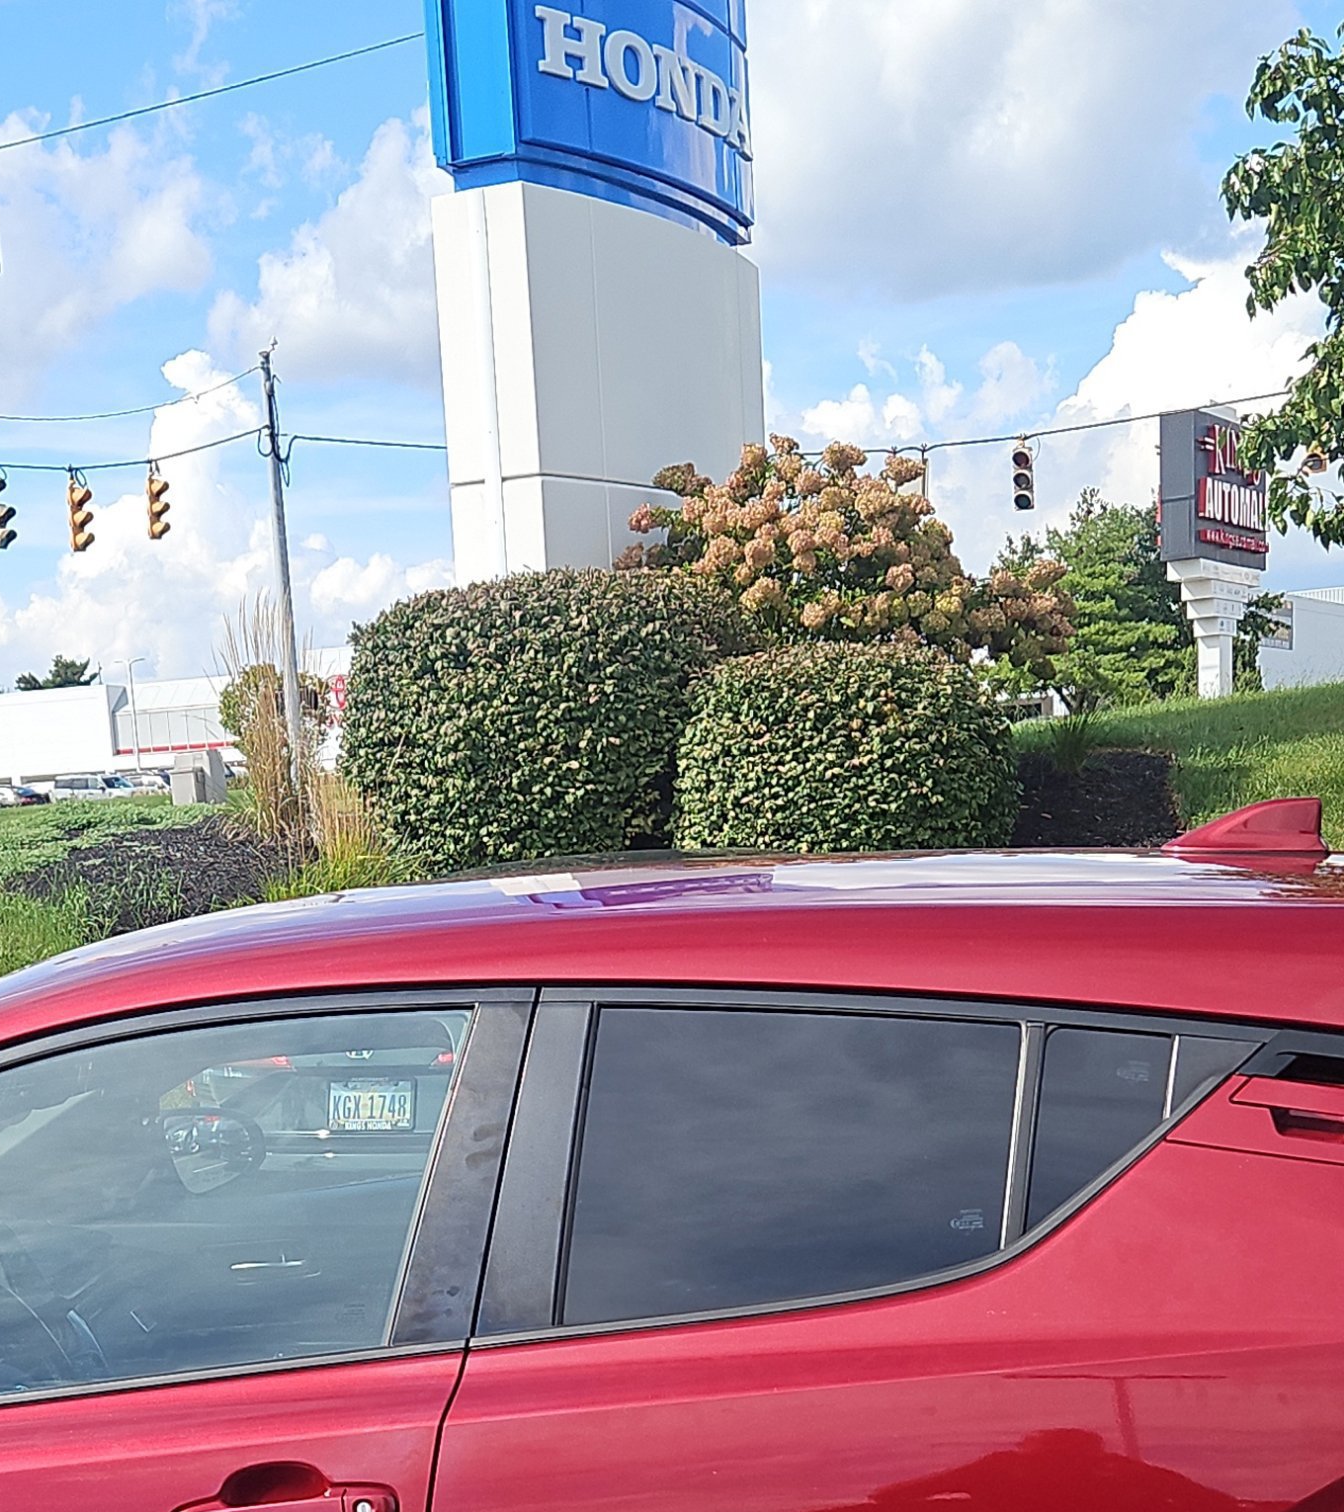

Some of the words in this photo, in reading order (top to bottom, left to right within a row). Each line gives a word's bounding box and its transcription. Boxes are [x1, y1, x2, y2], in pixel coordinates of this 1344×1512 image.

[534, 4, 754, 162] HONDA
[332, 1094, 361, 1120] KGX
[368, 1094, 407, 1119] 1748
